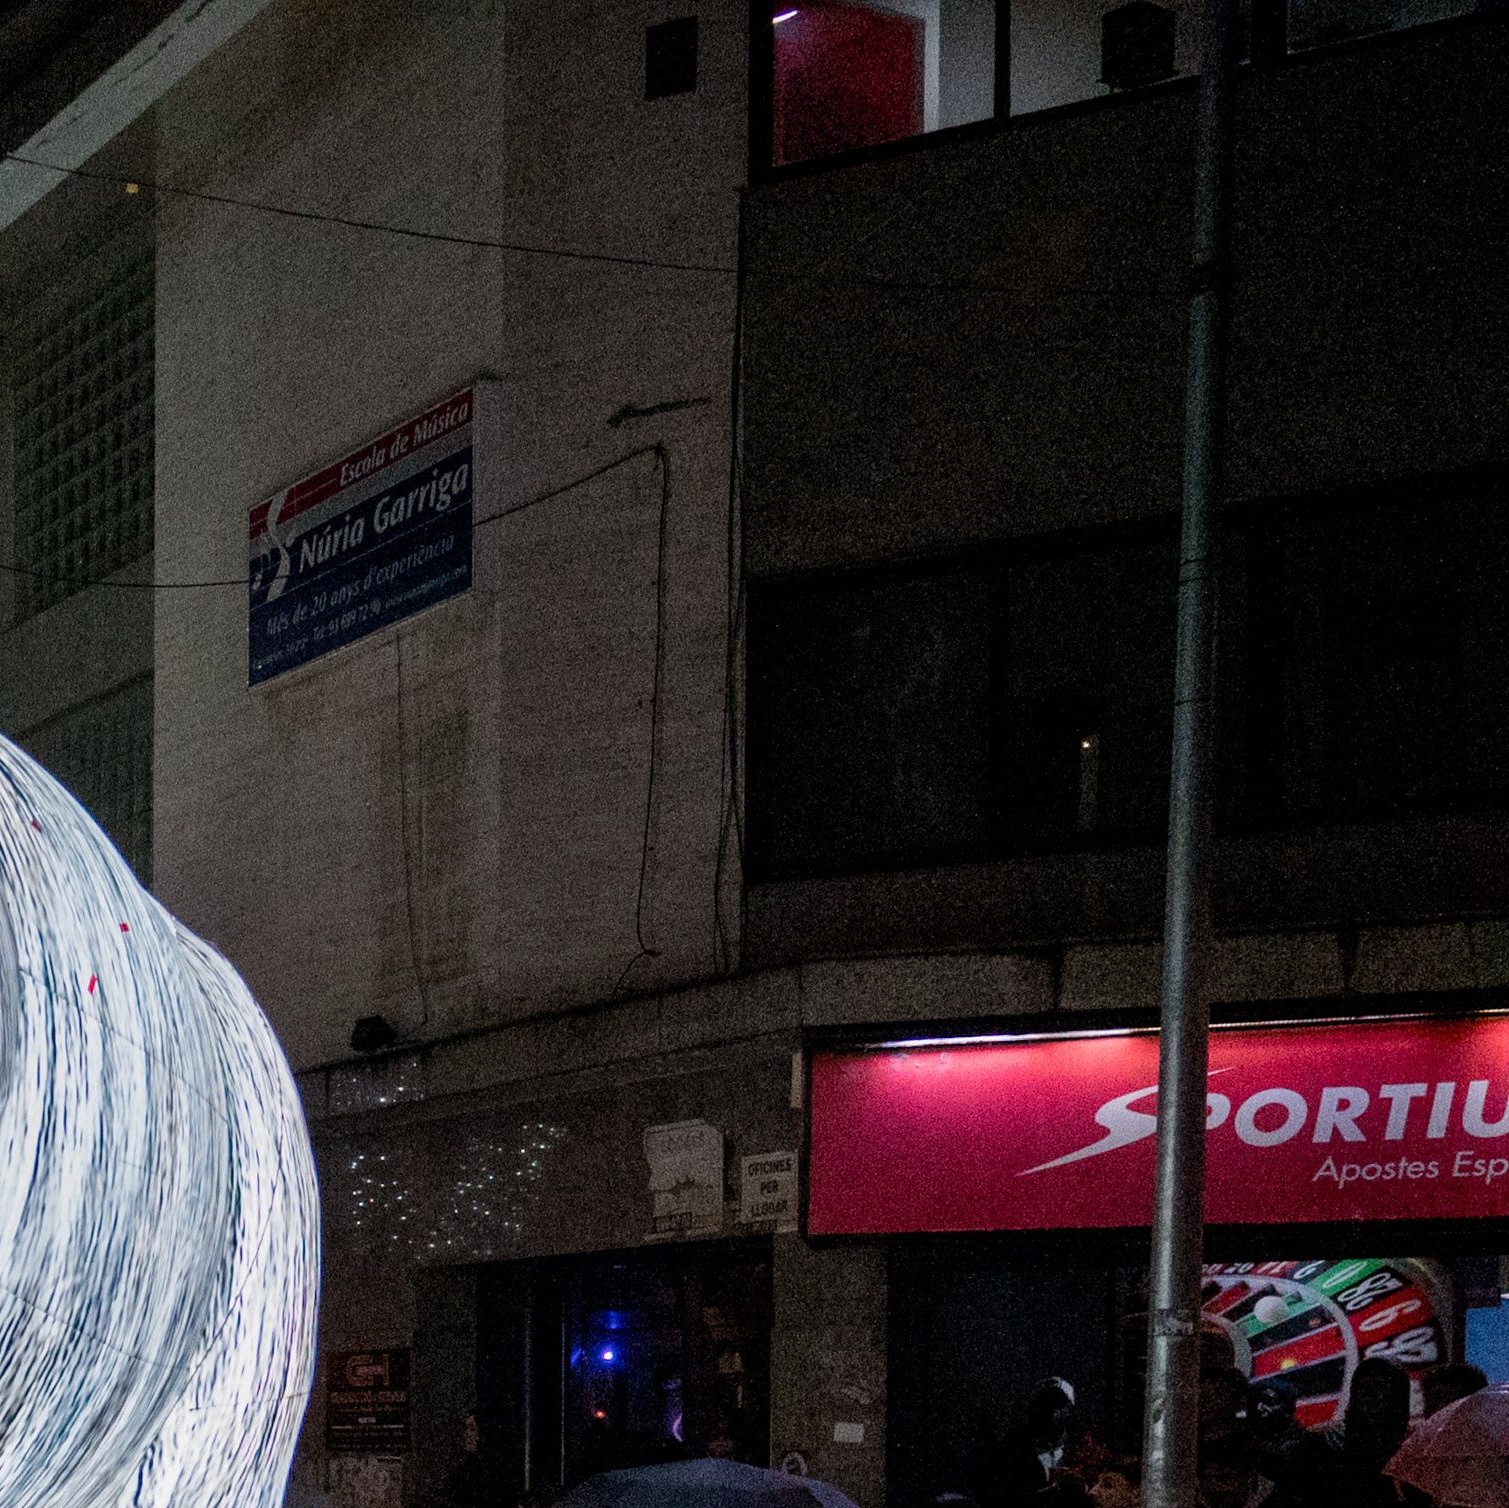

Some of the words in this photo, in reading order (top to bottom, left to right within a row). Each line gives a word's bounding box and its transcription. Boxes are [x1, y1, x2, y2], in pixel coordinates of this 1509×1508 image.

[339, 444, 385, 487] Escola
[389, 432, 409, 460] de
[413, 402, 469, 446] Música
[298, 513, 364, 574] Núria
[373, 462, 470, 534] Garriga
[1311, 1154, 1441, 1190] Apostes
